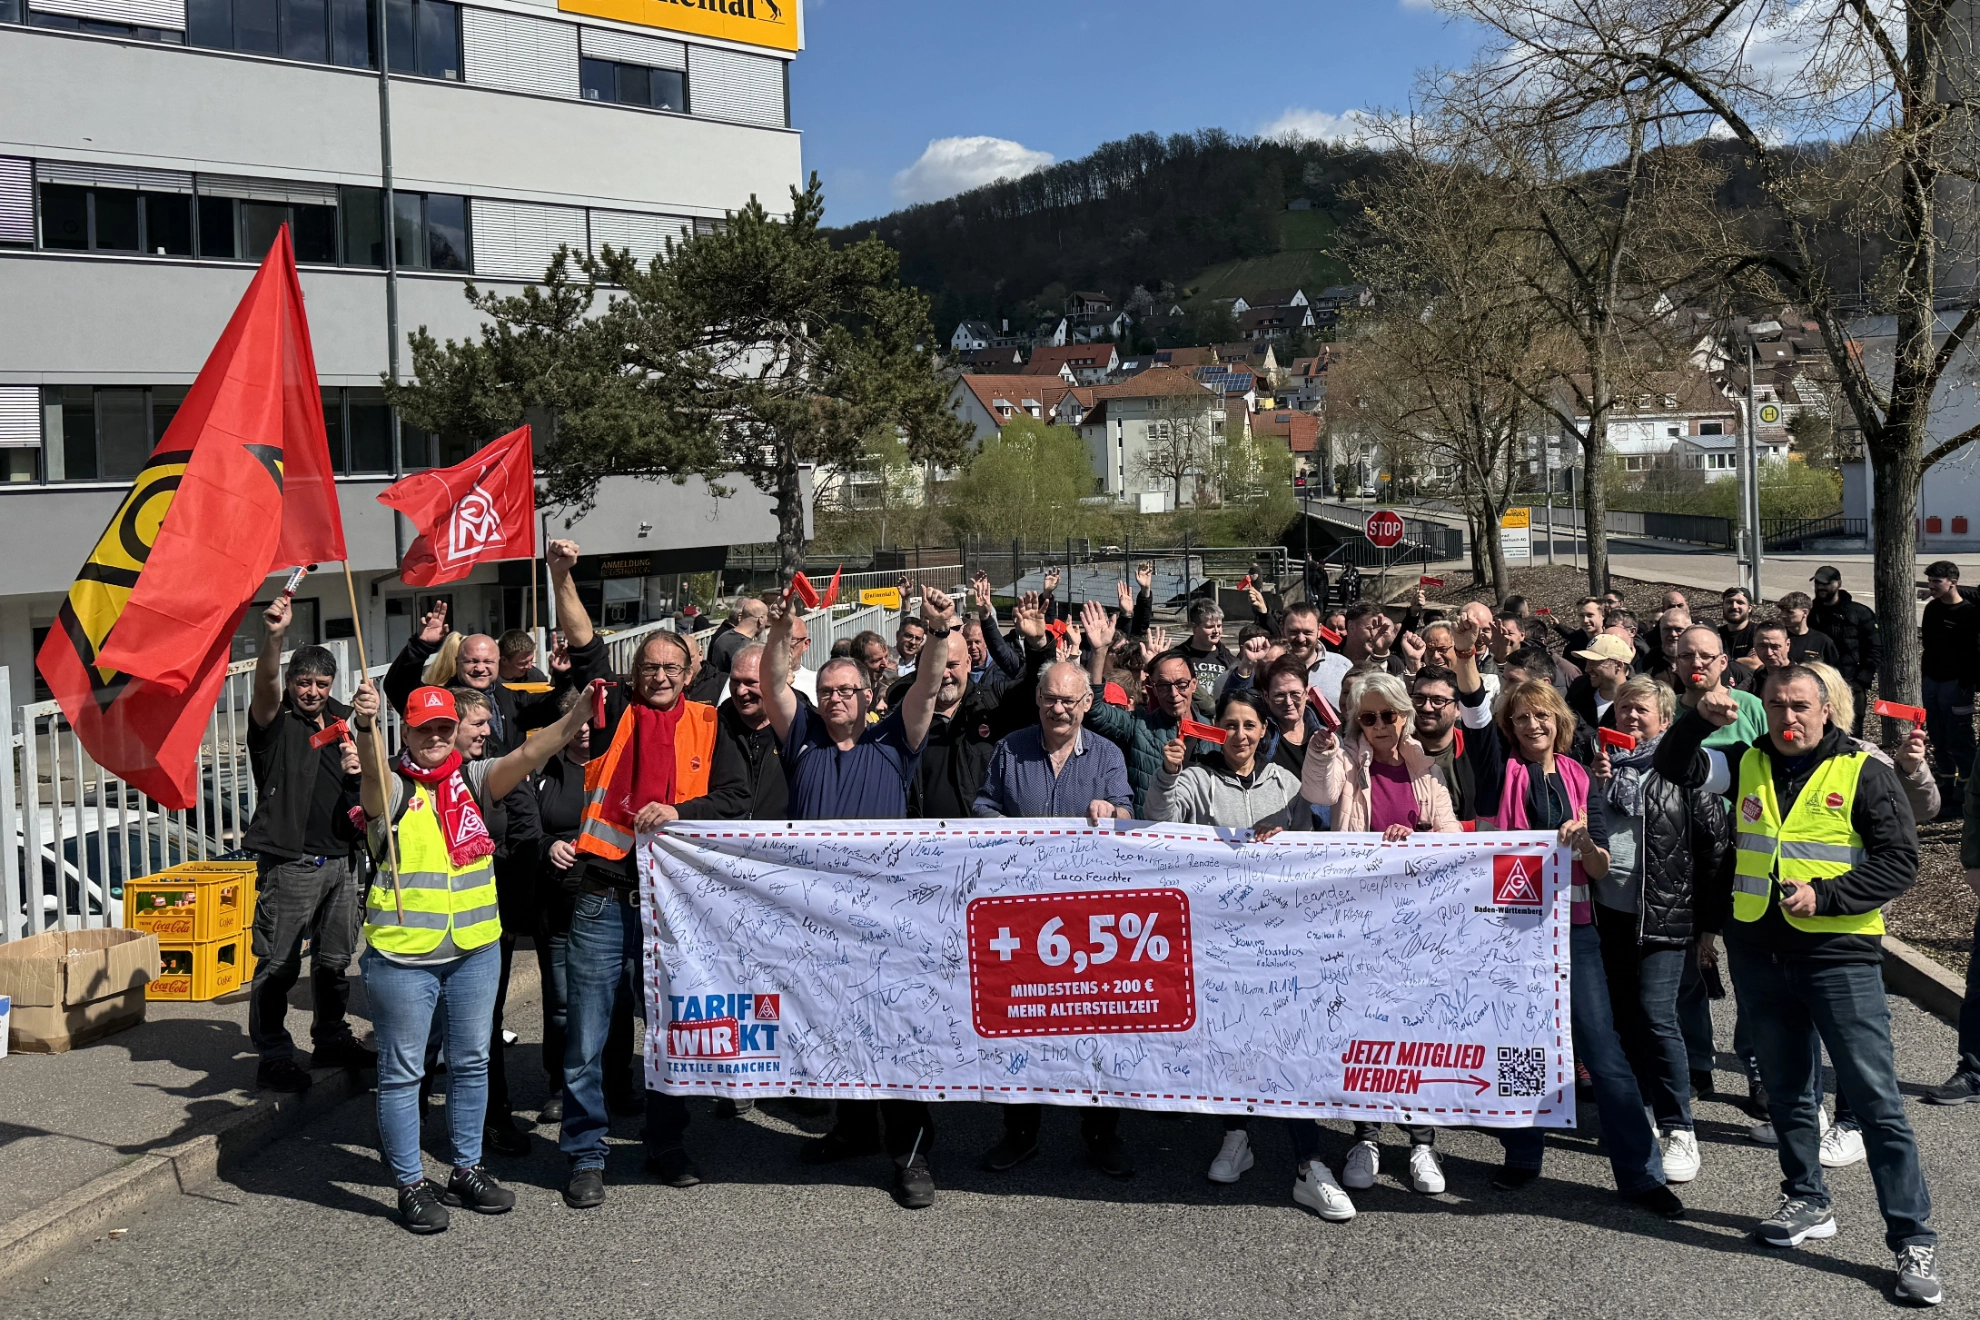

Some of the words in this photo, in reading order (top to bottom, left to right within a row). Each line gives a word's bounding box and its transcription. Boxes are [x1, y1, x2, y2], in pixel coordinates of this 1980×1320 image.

[1370, 521, 1400, 536] STOP
[601, 559, 650, 570] ANMELDUNG
[1085, 872, 1132, 883] Feuchter
[1474, 905, 1543, 915] Baden-Württemberg
[1036, 912, 1170, 974] 6,5%
[1010, 981, 1098, 998] MINDESTENS
[1113, 979, 1141, 994] 200
[1144, 978, 1154, 993] €
[667, 994, 753, 1021] TARIF
[1007, 1003, 1047, 1018] MEHR
[1050, 999, 1160, 1017] ALTERSTEILZEIT
[1341, 1040, 1395, 1065] JETZT
[1396, 1042, 1486, 1069] MITGLIED
[667, 1062, 713, 1073] TEXTILE
[717, 1061, 780, 1074] BRANCHEN
[1342, 1067, 1422, 1094] WERDEN
